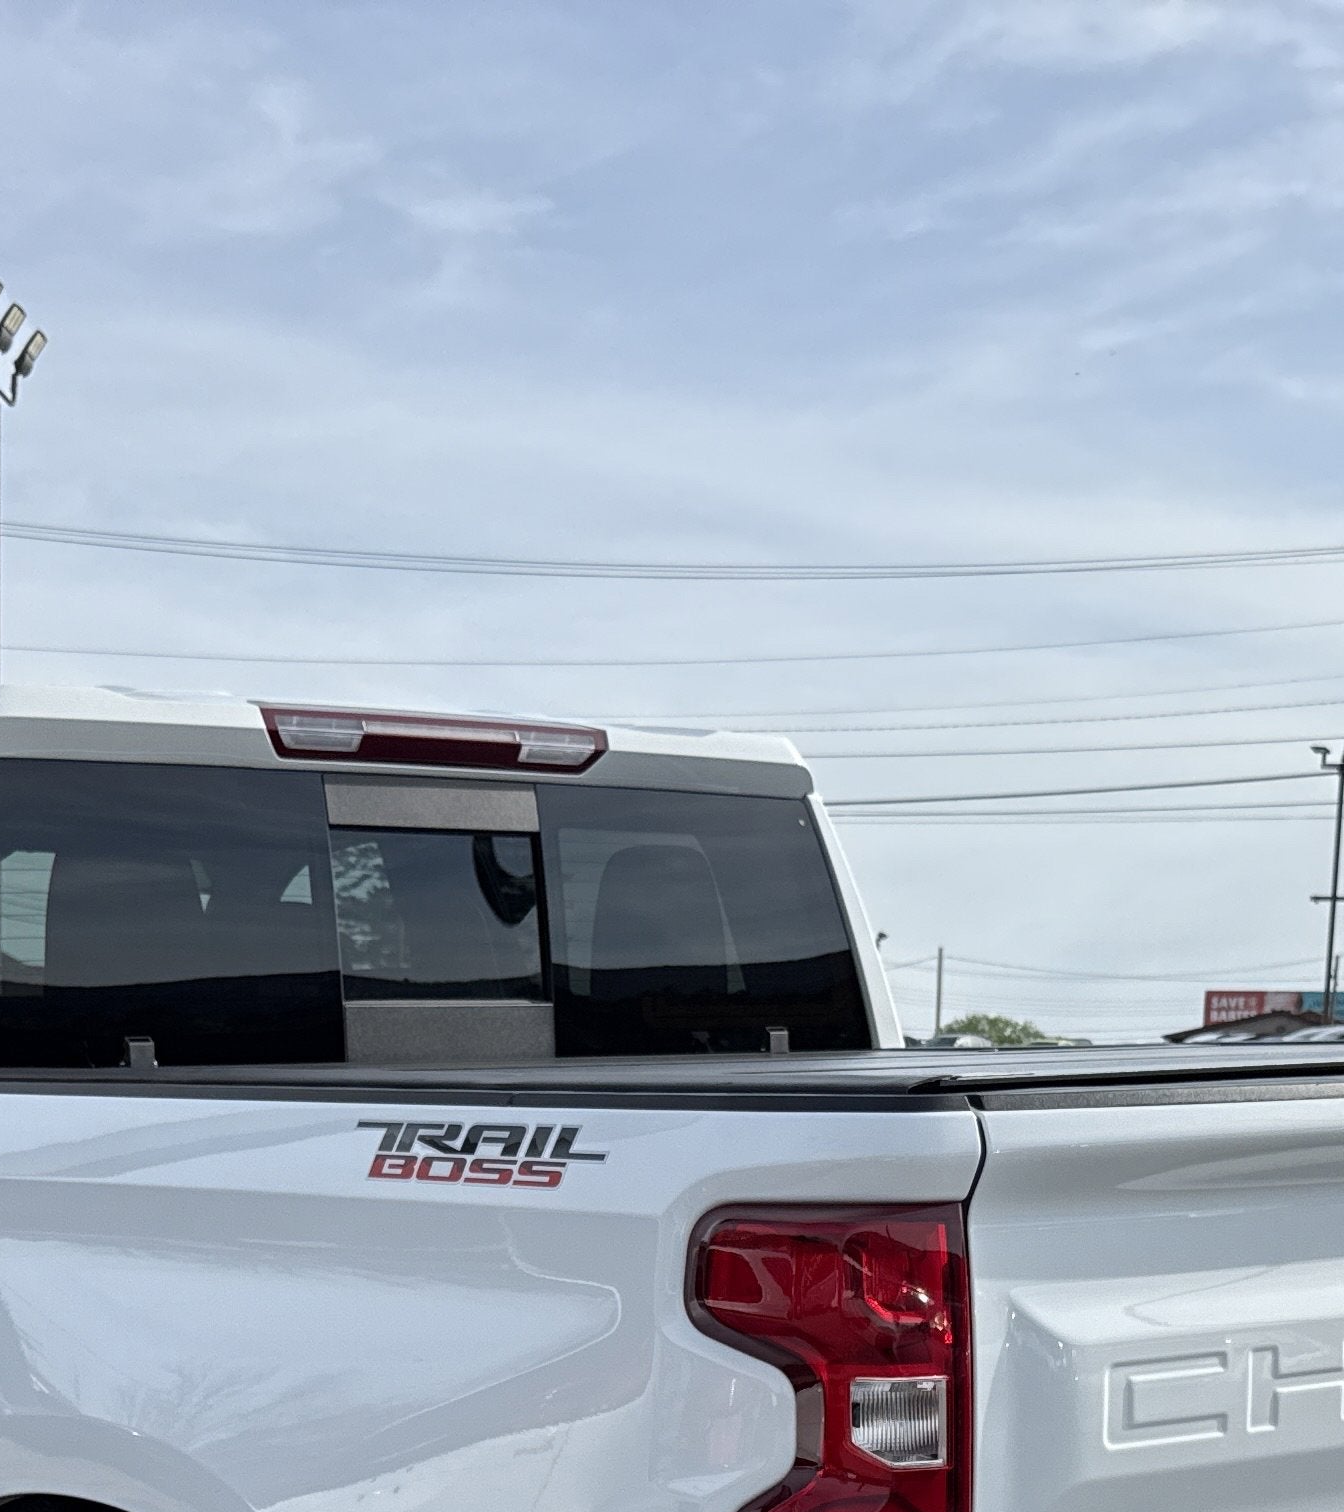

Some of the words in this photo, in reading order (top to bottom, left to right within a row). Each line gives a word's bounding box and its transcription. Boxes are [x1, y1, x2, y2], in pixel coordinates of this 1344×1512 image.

[1210, 996, 1245, 1009] SAVE
[356, 1120, 608, 1162] TRAIL
[366, 1153, 568, 1189] BOSS
